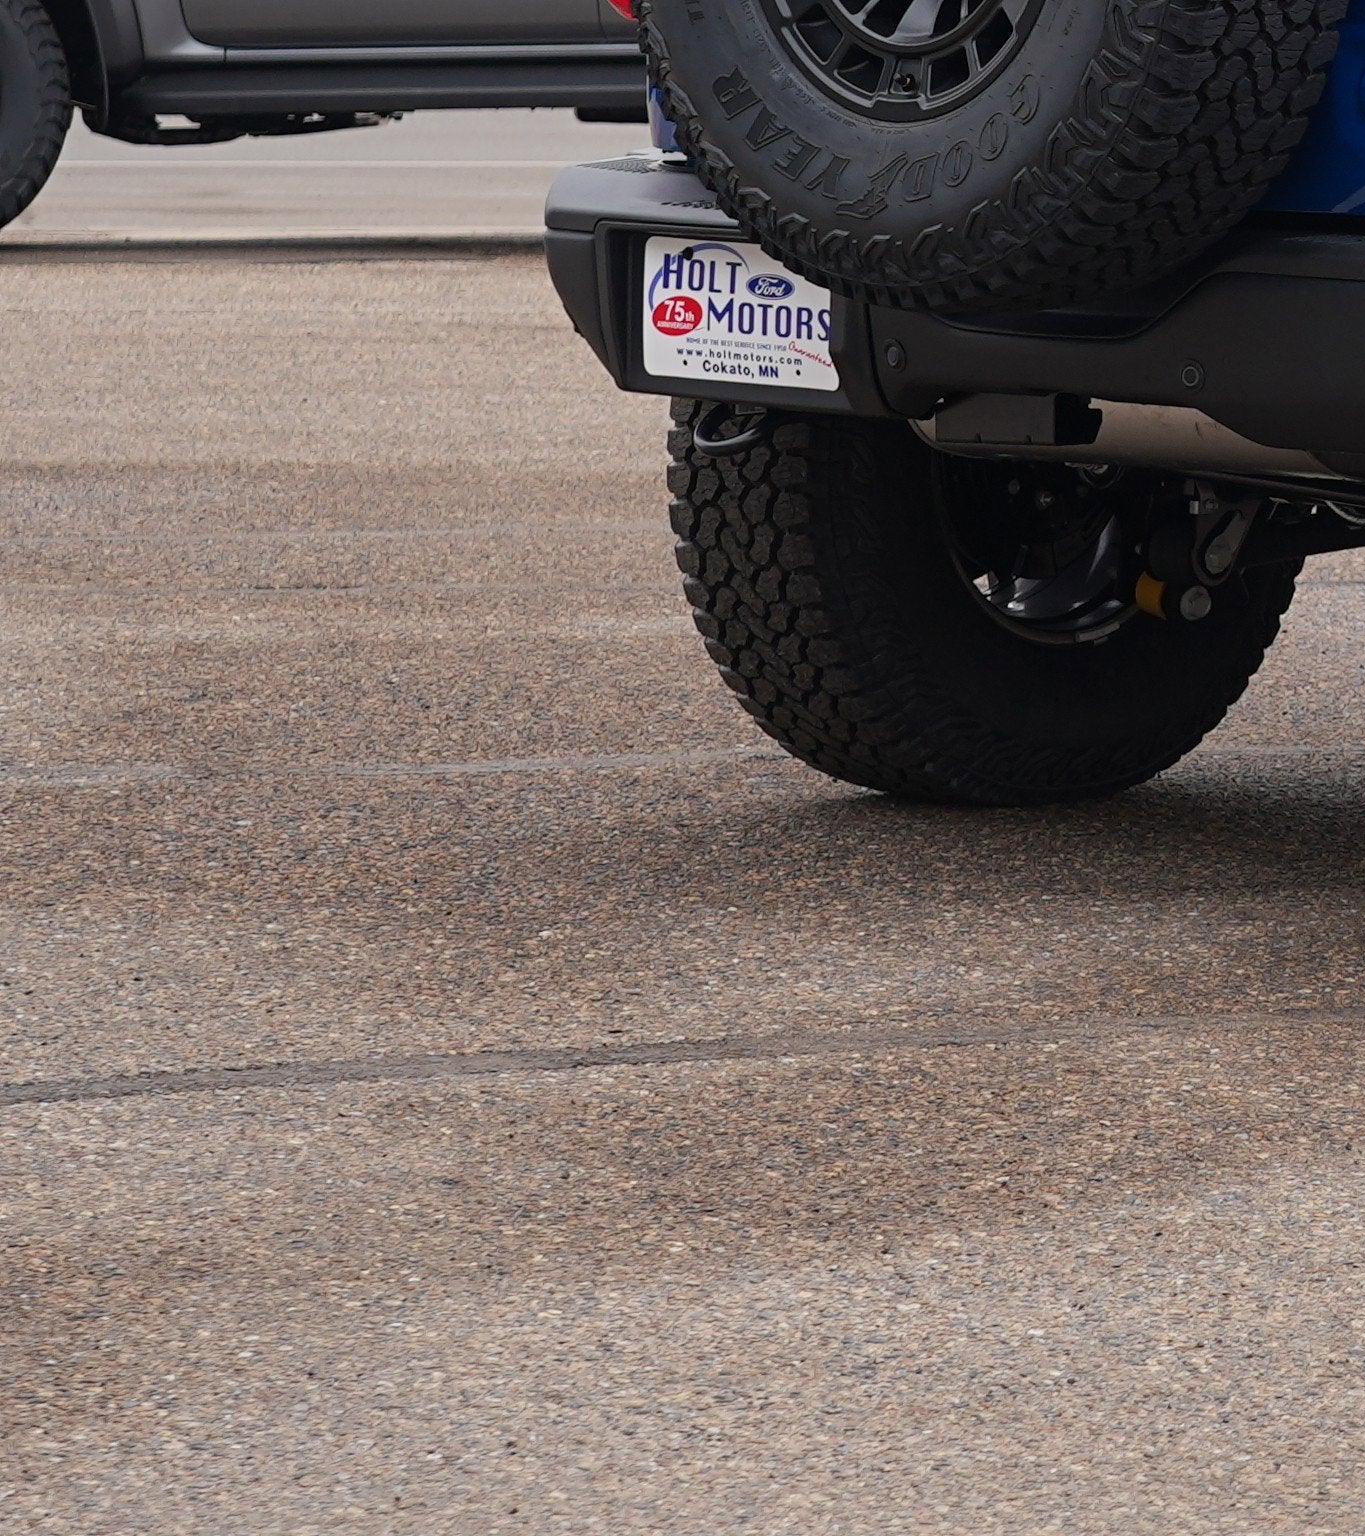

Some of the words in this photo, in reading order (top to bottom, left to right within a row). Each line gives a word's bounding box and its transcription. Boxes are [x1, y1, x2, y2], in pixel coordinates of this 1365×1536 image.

[662, 253, 743, 294] HOLT
[754, 276, 787, 298] Ford
[664, 300, 695, 322] 75th
[707, 296, 832, 341] MOTORS
[676, 346, 803, 367] www.holtmotors.com
[702, 359, 755, 379] Cokato,
[758, 364, 779, 378] MN
